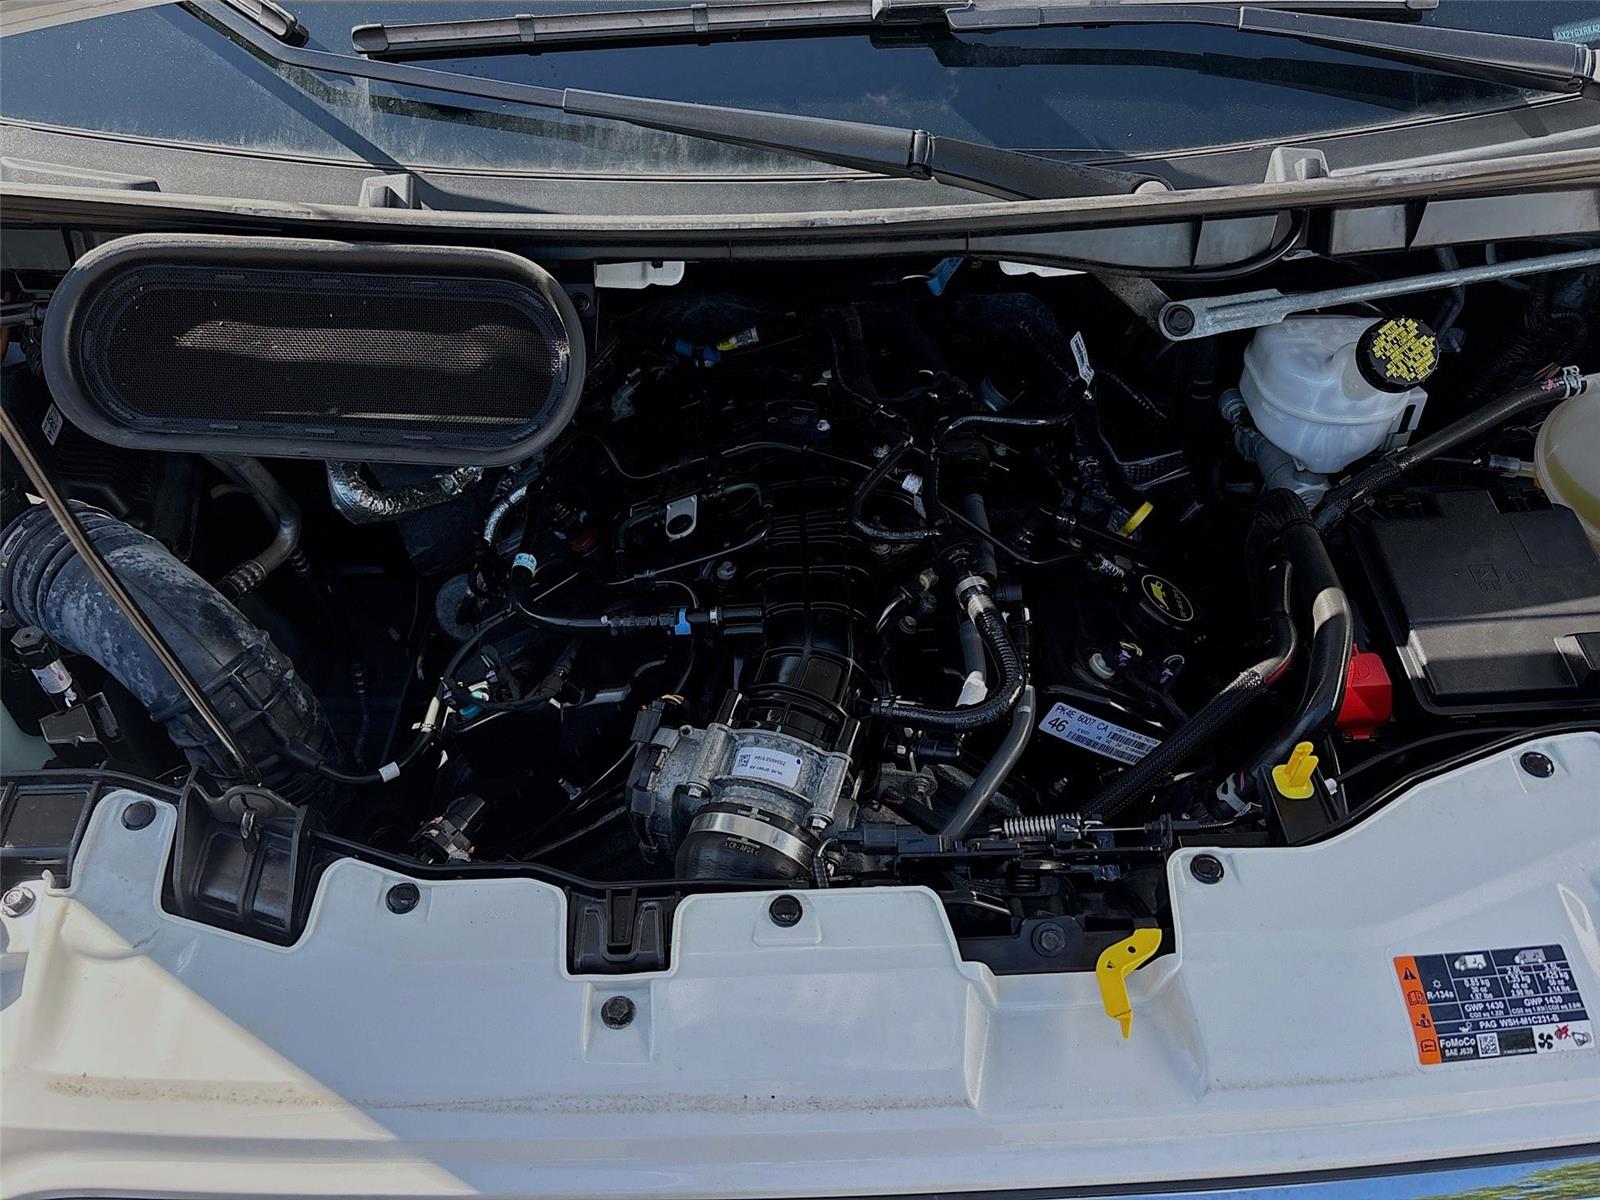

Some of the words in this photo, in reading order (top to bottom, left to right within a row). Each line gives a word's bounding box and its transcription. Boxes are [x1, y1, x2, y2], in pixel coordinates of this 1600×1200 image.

[1055, 705, 1076, 719] PK4E
[1077, 714, 1096, 726] 6007
[1097, 722, 1109, 733] CA
[1047, 717, 1069, 732] 46
[1522, 974, 1531, 984] kg
[1560, 971, 1570, 980] kg
[1481, 978, 1491, 988] kg
[1426, 990, 1454, 1000] R-134a
[1524, 998, 1544, 1006] GWP
[1546, 996, 1563, 1005] 1430
[1464, 1003, 1484, 1012] GWP
[1486, 1001, 1504, 1010] 1430
[1479, 1020, 1497, 1030] PAG
[1499, 1014, 1560, 1027] WSH-M1C231-B
[1440, 1037, 1476, 1048] FoMoCo
[1444, 1048, 1458, 1056] SAE
